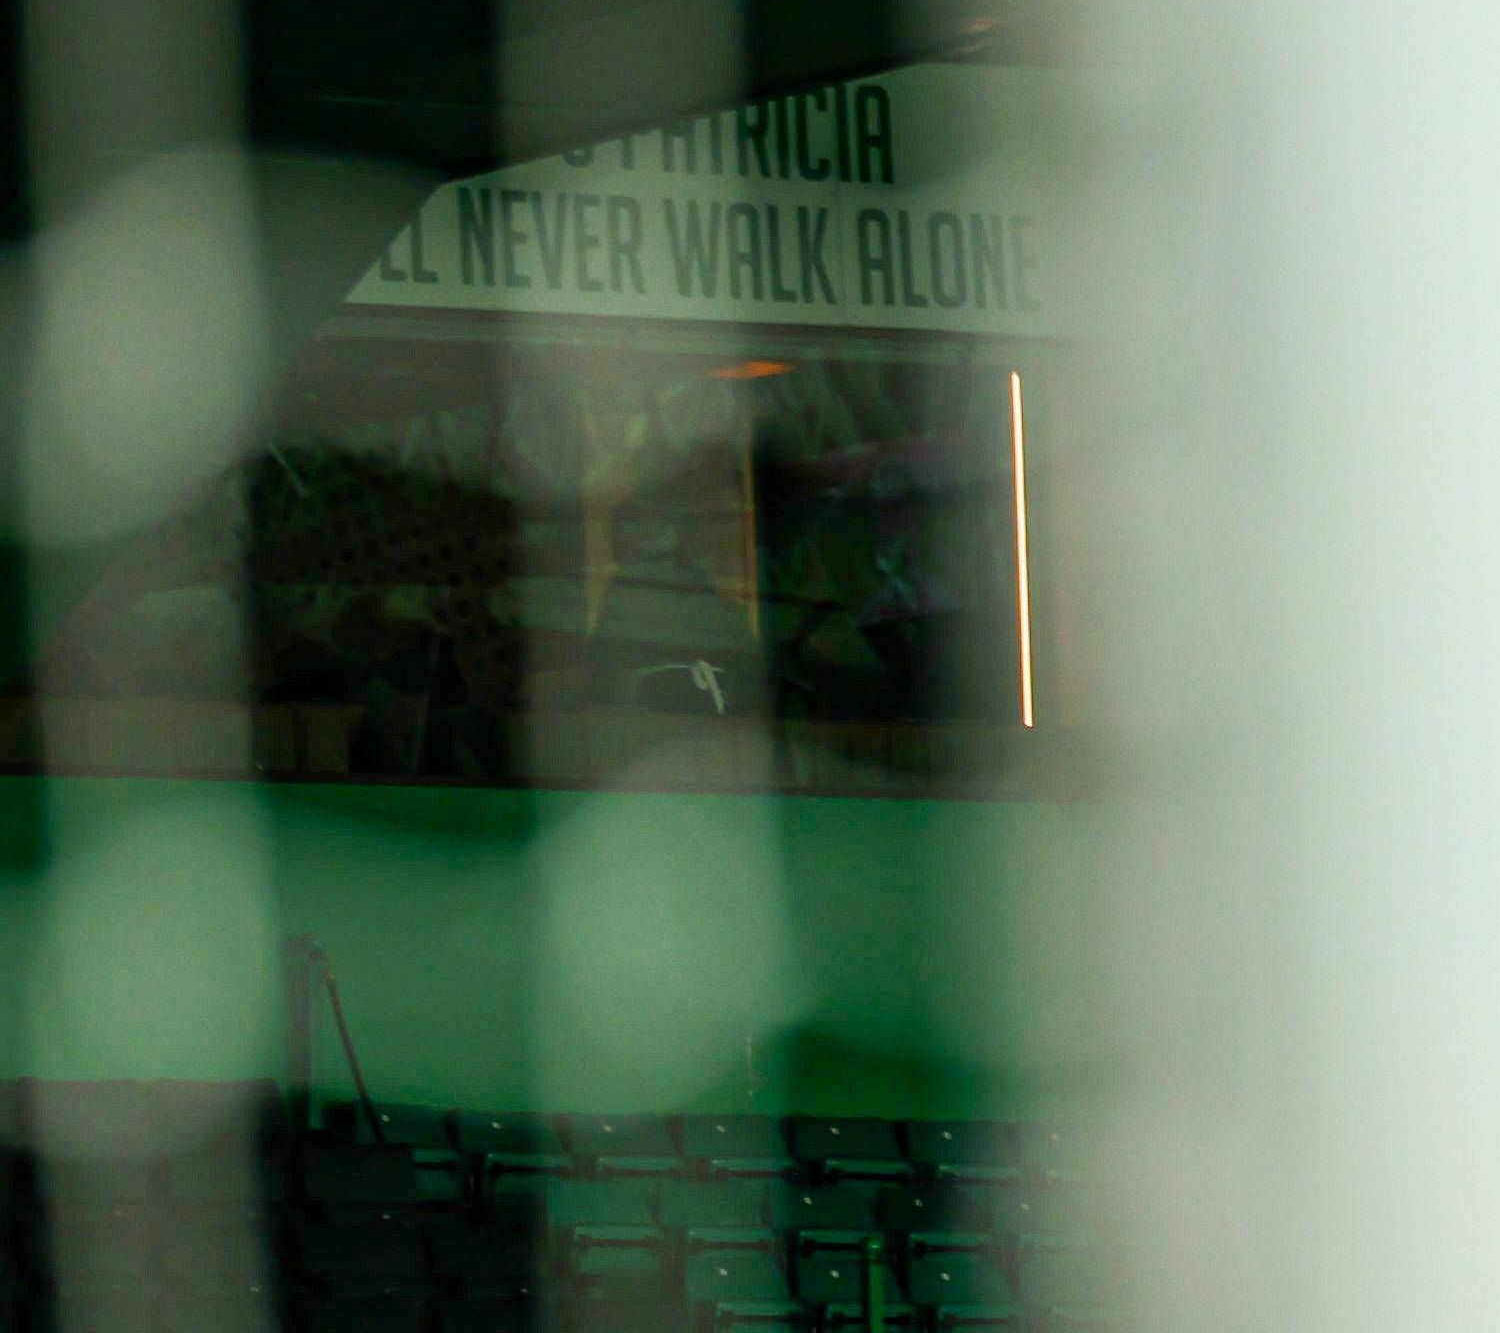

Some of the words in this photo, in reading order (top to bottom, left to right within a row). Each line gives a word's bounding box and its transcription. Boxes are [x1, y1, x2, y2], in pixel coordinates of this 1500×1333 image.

[455, 186, 647, 295] NEVER
[662, 198, 837, 305] WALK
[857, 208, 1042, 314] ALONE
